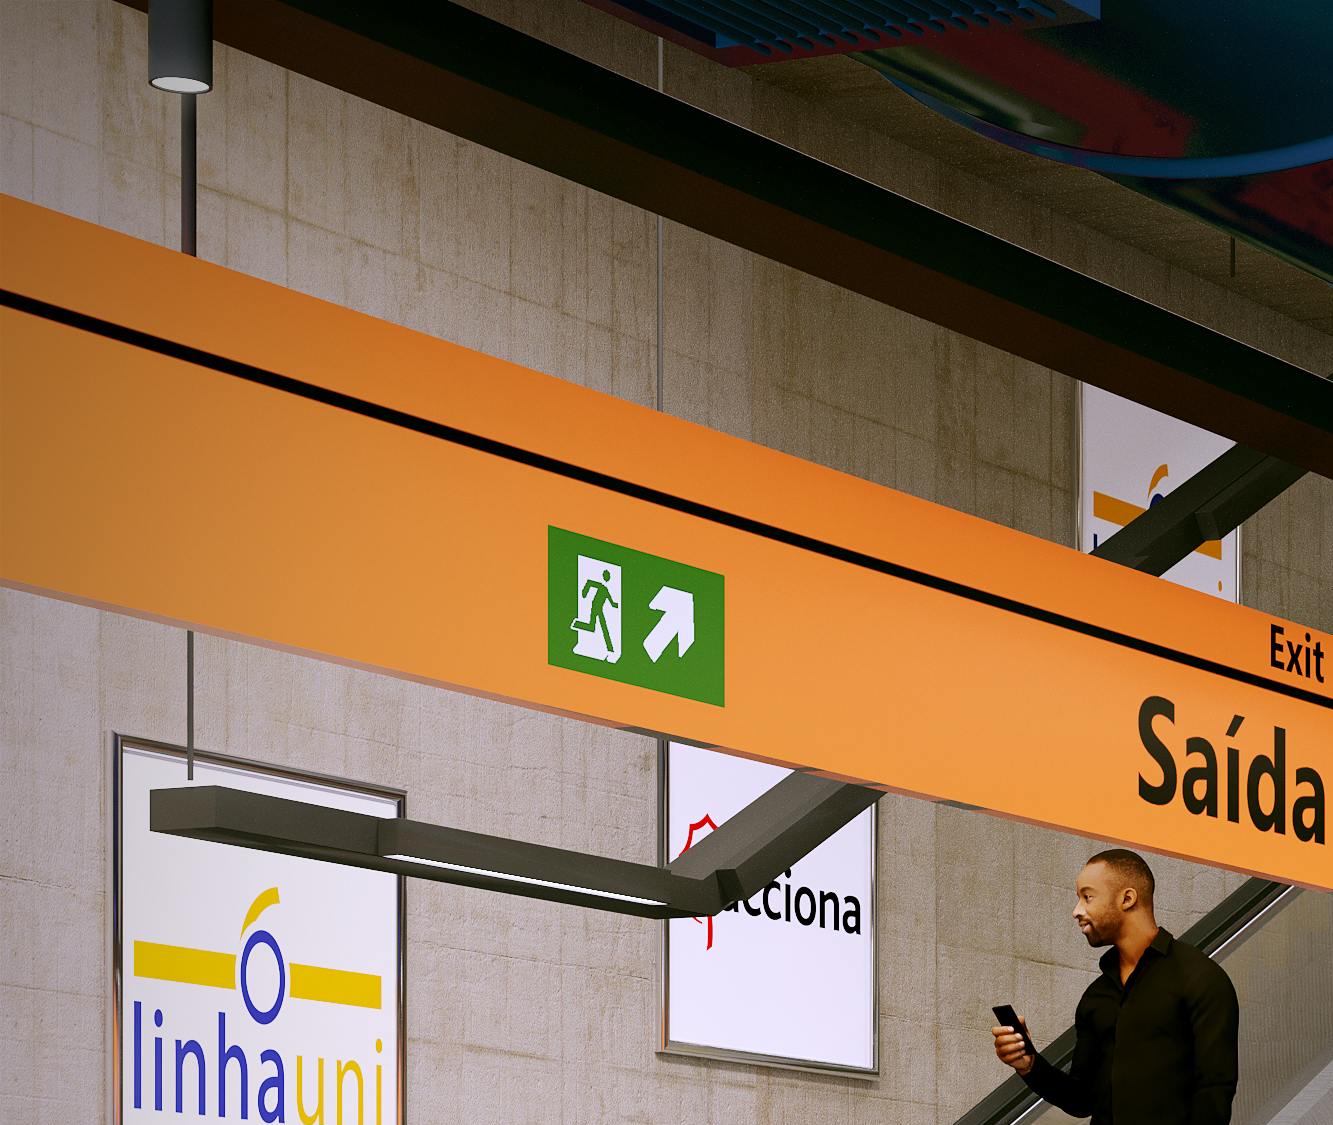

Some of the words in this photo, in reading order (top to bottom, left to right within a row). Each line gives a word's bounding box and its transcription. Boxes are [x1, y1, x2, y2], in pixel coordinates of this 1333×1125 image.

[1269, 623, 1325, 683] Exit
[1137, 695, 1326, 845] Saída
[722, 867, 861, 935] ciona
